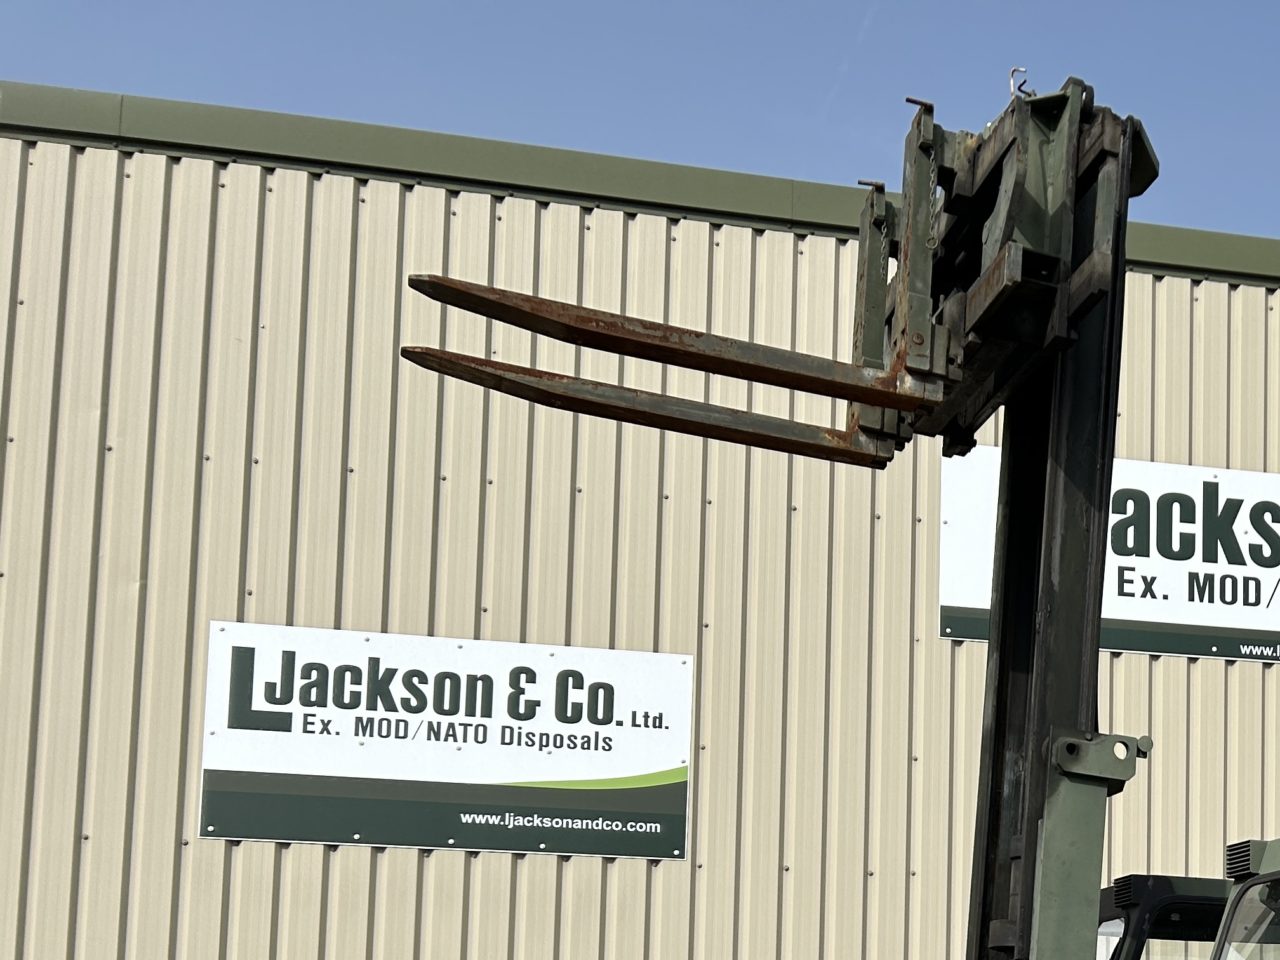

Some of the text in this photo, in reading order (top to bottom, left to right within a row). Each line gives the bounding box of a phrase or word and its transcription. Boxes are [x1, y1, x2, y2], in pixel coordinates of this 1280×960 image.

[1117, 566, 1169, 601] Ex.
[506, 666, 541, 721] &
[555, 669, 624, 727] Co.
[631, 710, 670, 730] Ltd.
[302, 713, 613, 752] Ex. MOD/NATO Disposals
[460, 812, 662, 834] www.ljacksonandco.com
